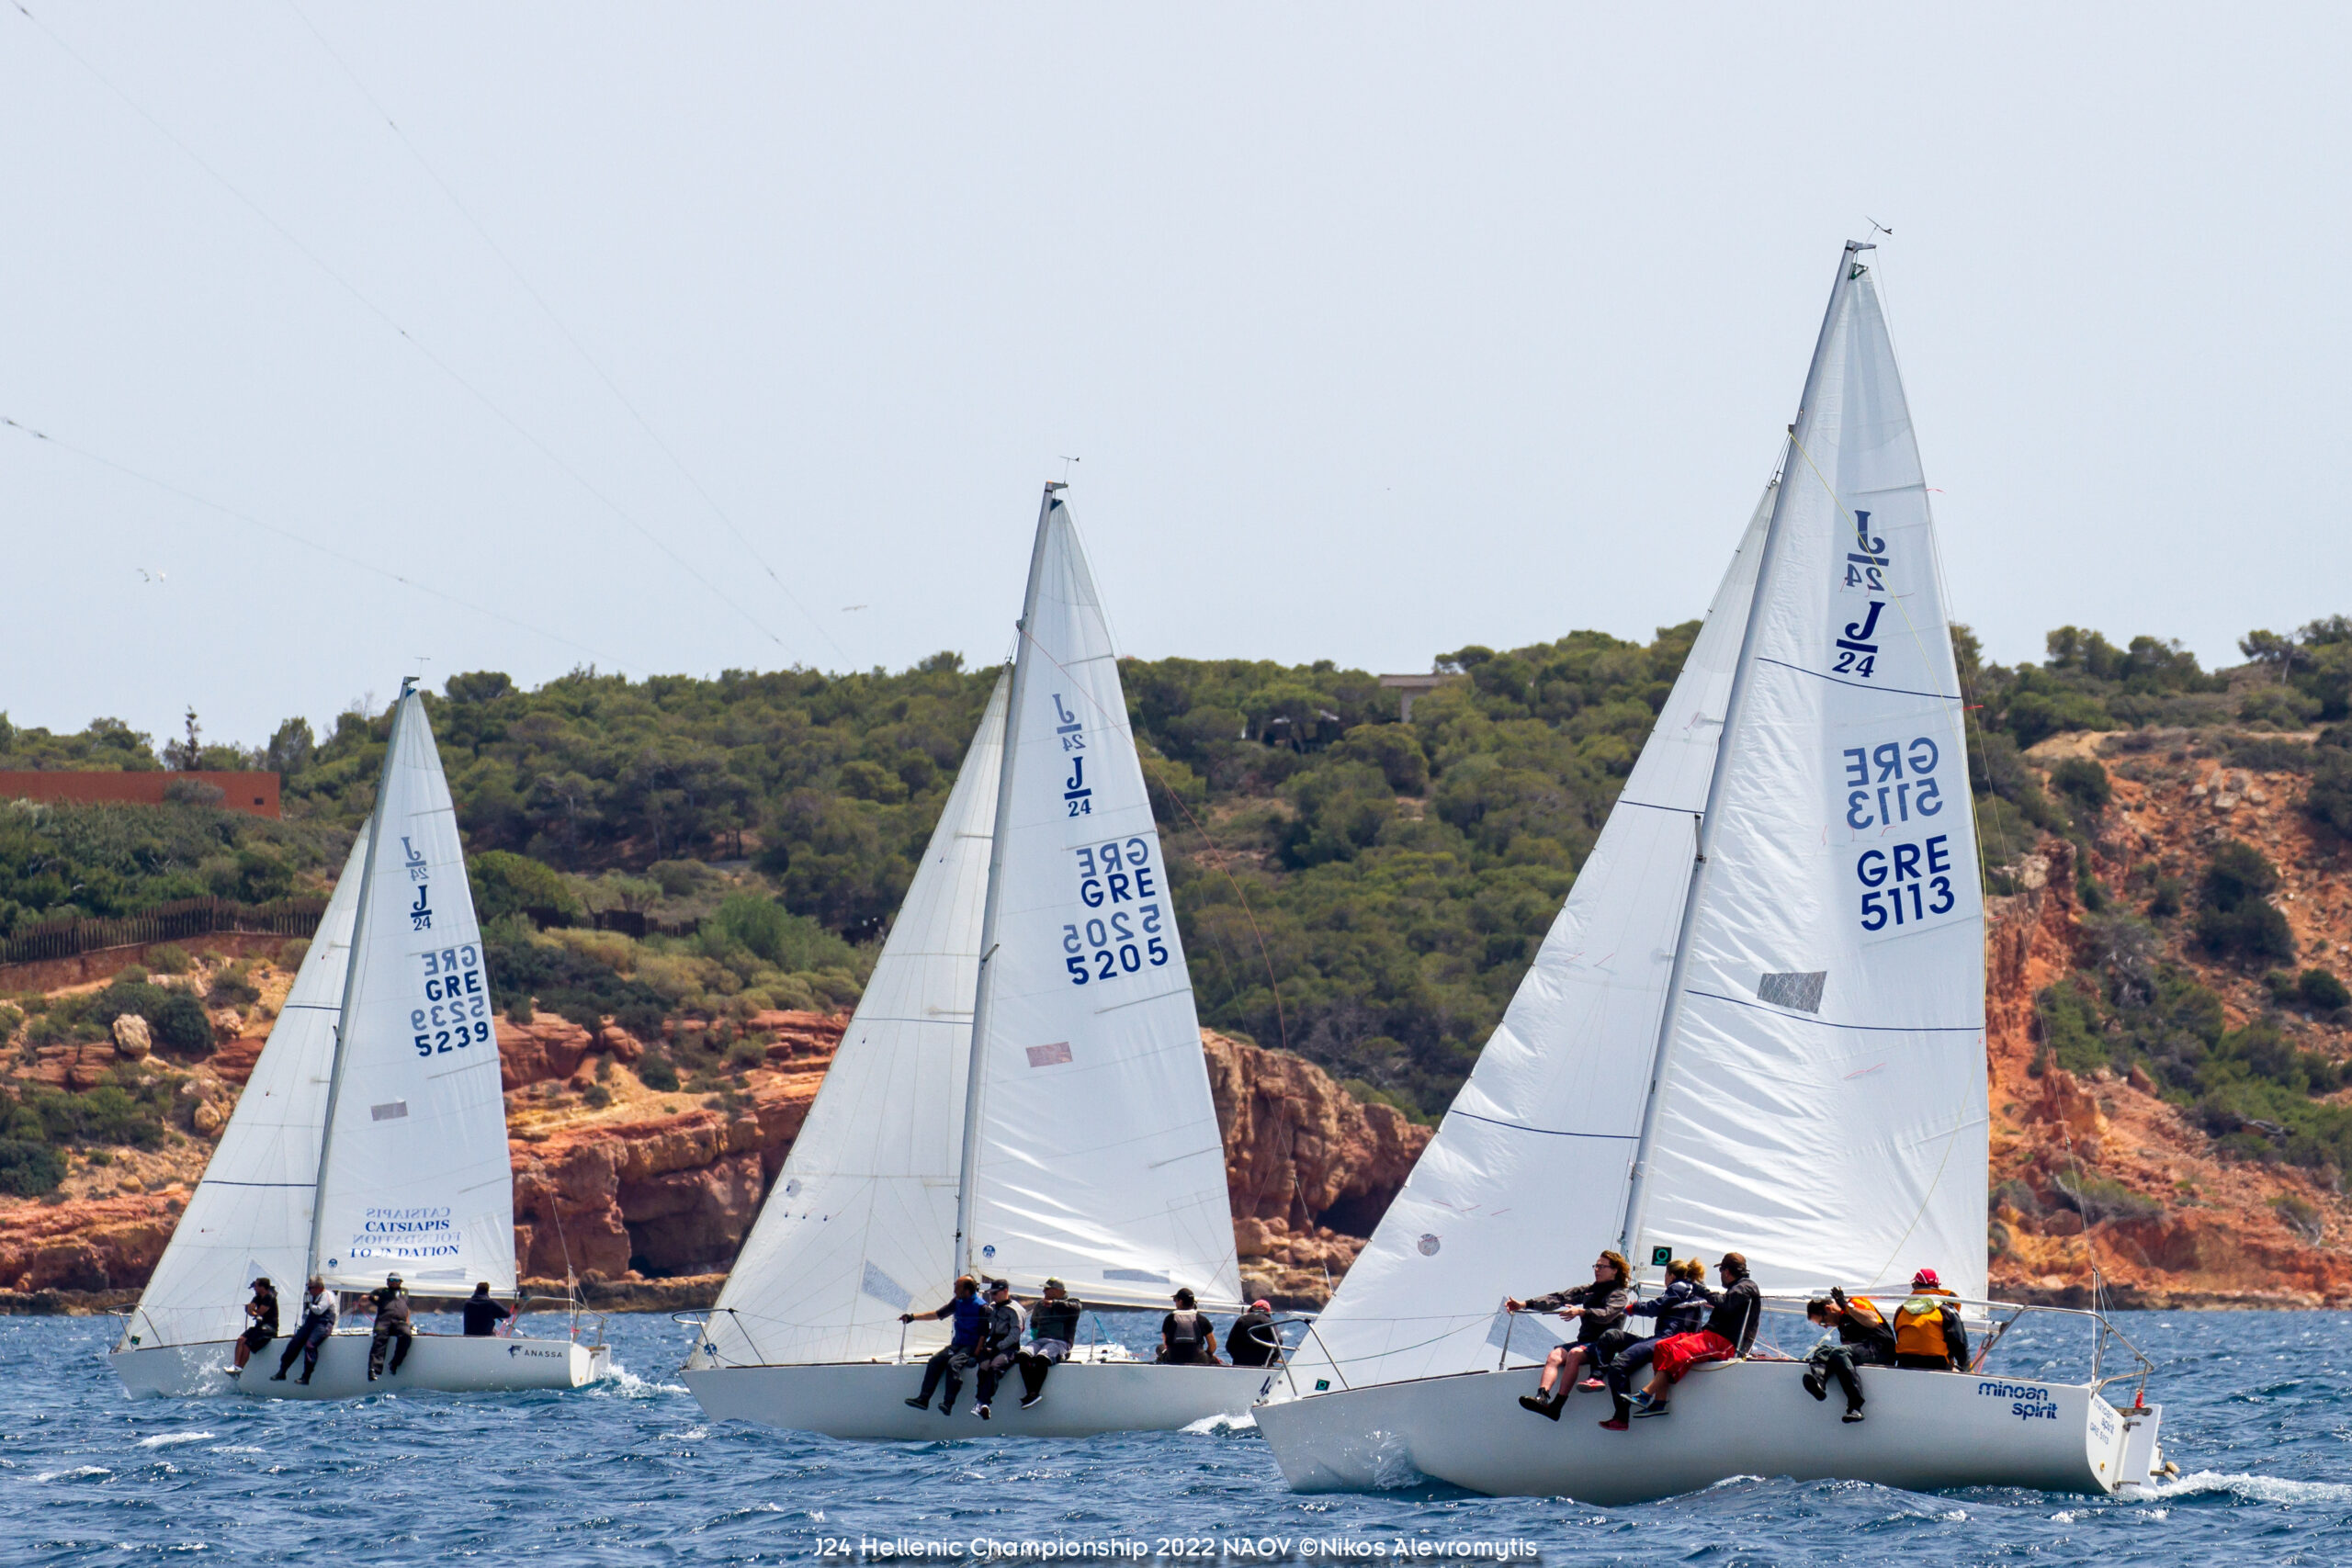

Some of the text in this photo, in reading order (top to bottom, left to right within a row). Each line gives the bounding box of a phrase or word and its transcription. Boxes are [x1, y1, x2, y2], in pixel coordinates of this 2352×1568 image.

[1845, 601, 1886, 641] J
[1832, 651, 1875, 678] 24
[1067, 756, 1083, 790] J
[1068, 798, 1091, 818] 24
[1857, 834, 1951, 887] GRE
[413, 885, 427, 910] J
[1080, 867, 1156, 908] GRE
[1860, 875, 1955, 931] 5113
[413, 916, 432, 931] 24
[1066, 936, 1169, 986] 5205
[425, 970, 481, 1002] GRE
[414, 1021, 489, 1056] 5239
[365, 1219, 450, 1233] CATSIAPIS
[350, 1245, 459, 1258] FODATION
[525, 1349, 562, 1358] ANASSA
[1978, 1381, 2048, 1401] minoan
[2011, 1401, 2057, 1420] spirit
